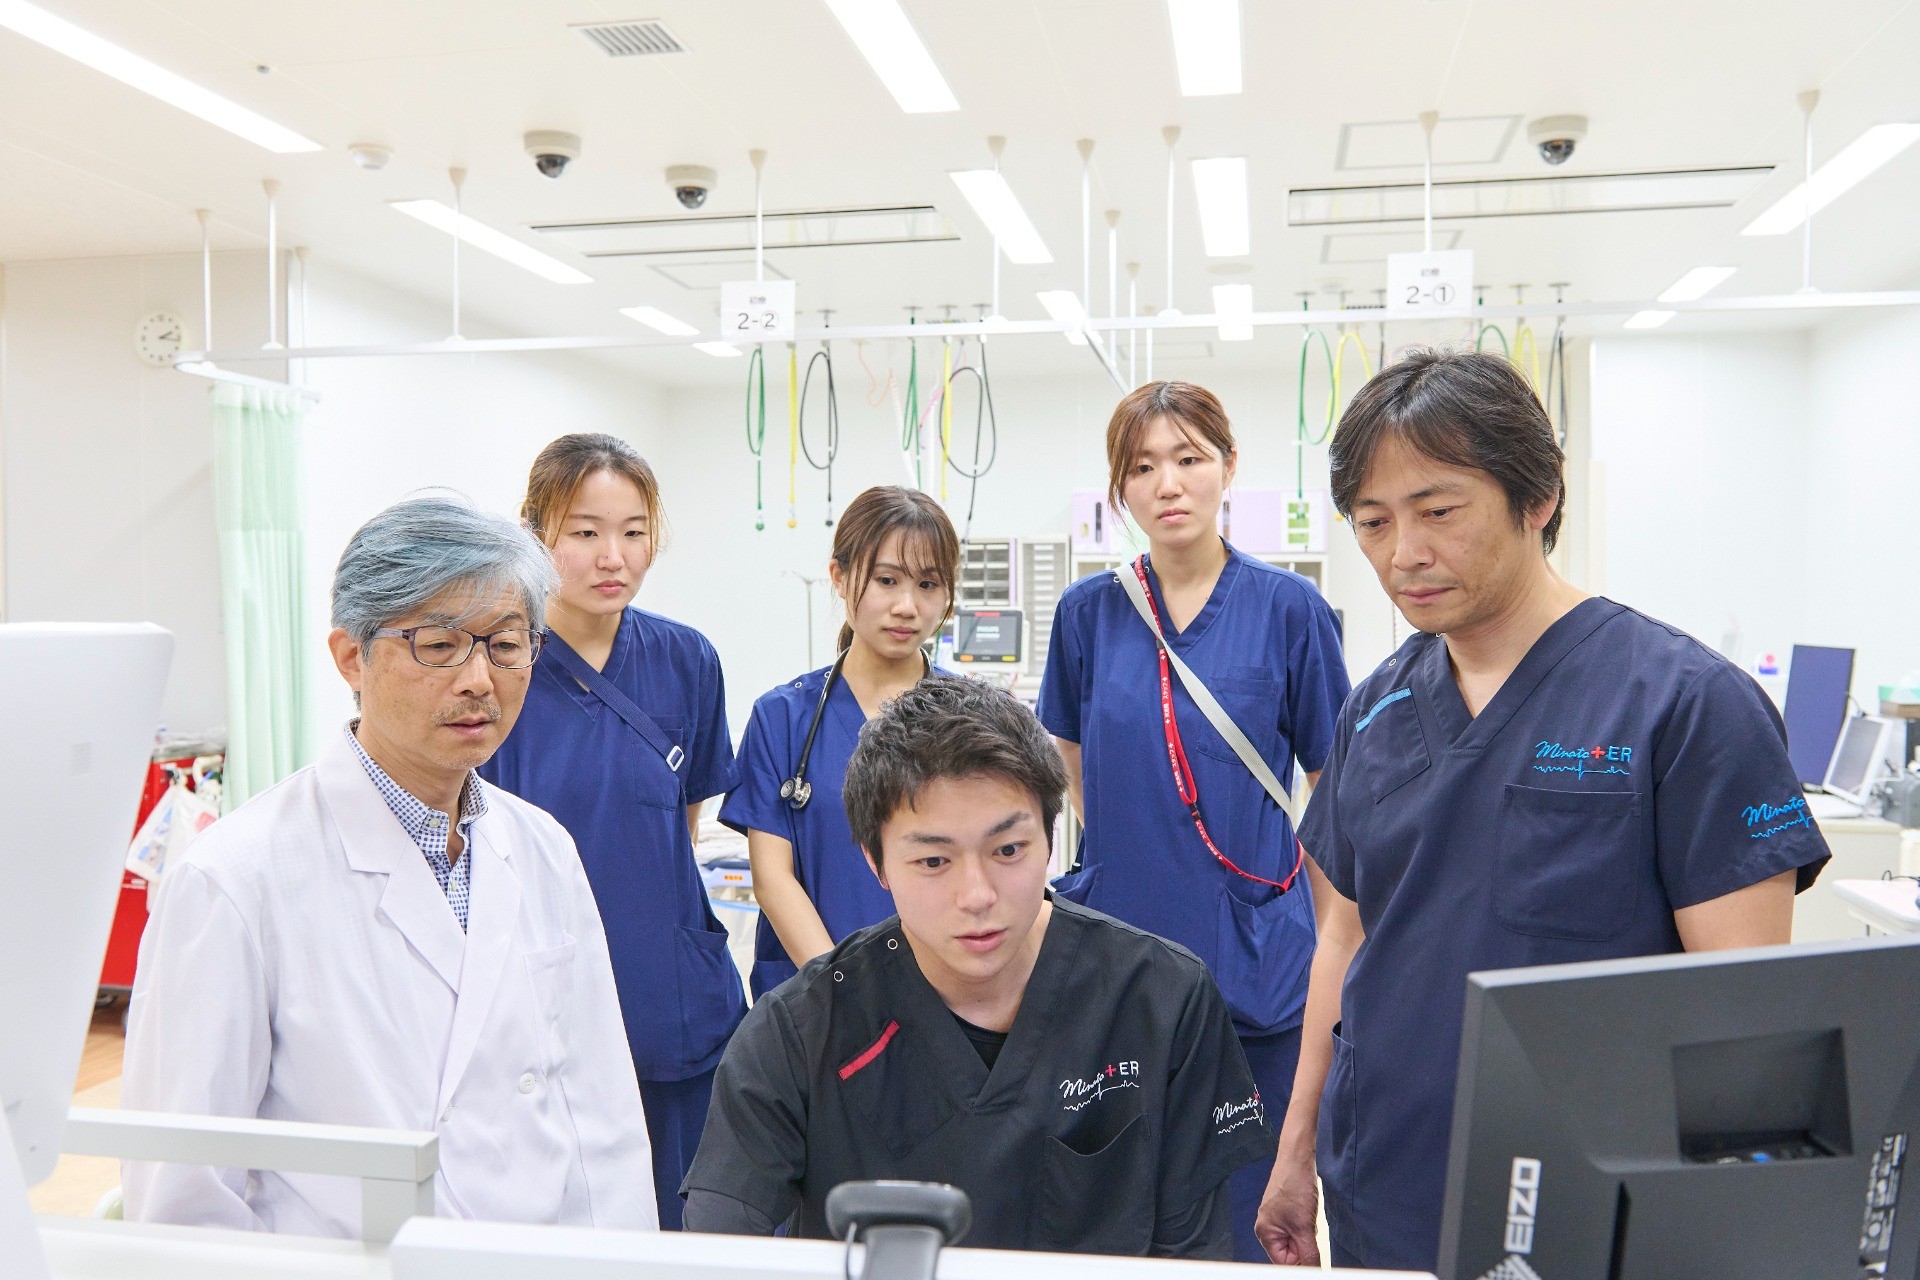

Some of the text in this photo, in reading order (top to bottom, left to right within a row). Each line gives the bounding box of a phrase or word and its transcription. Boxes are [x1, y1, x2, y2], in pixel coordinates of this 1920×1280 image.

[1535, 740, 1632, 763] Minato ER
[1119, 1060, 1140, 1078] ER
[1504, 1157, 1542, 1255] EIZO
